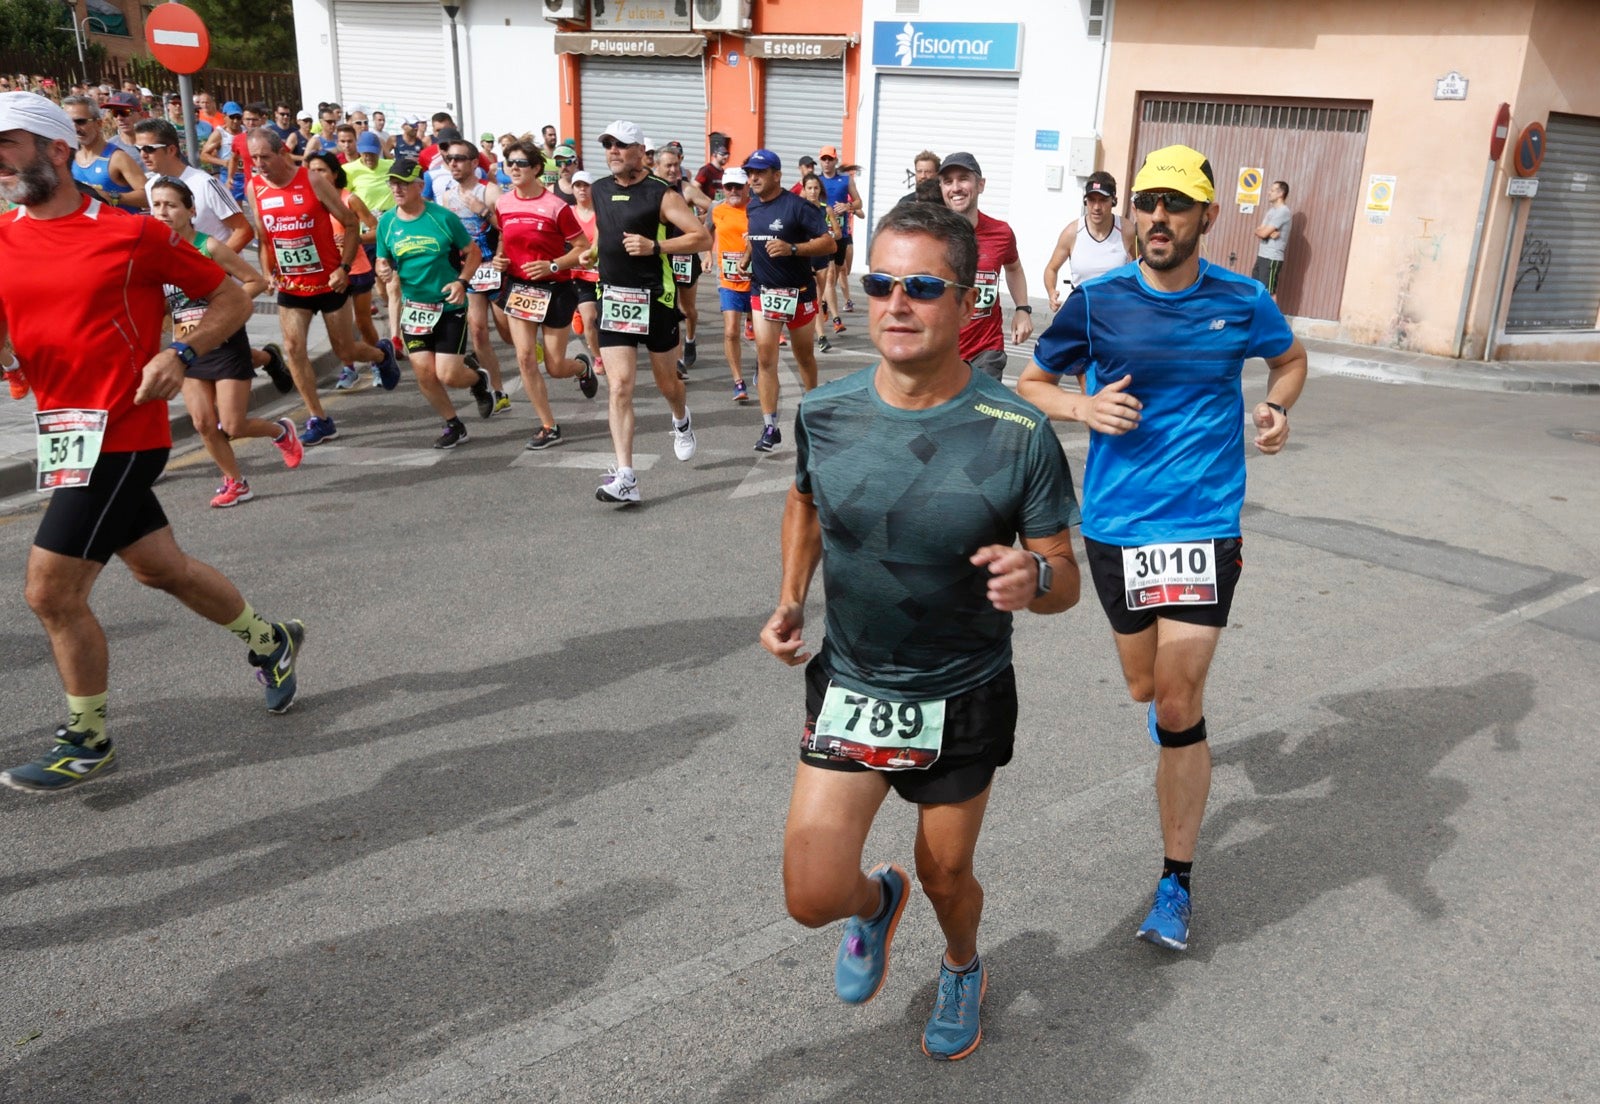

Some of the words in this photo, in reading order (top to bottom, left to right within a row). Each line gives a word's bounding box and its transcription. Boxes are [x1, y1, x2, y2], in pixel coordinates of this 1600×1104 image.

[764, 41, 821, 55] Estetica
[912, 32, 993, 58] fisiomar
[283, 249, 312, 264] 613
[611, 303, 642, 320] 562
[764, 295, 791, 311] 357
[409, 310, 434, 325] 469
[50, 435, 84, 465] 581
[1135, 547, 1206, 578] 3010
[844, 694, 924, 739] 789
